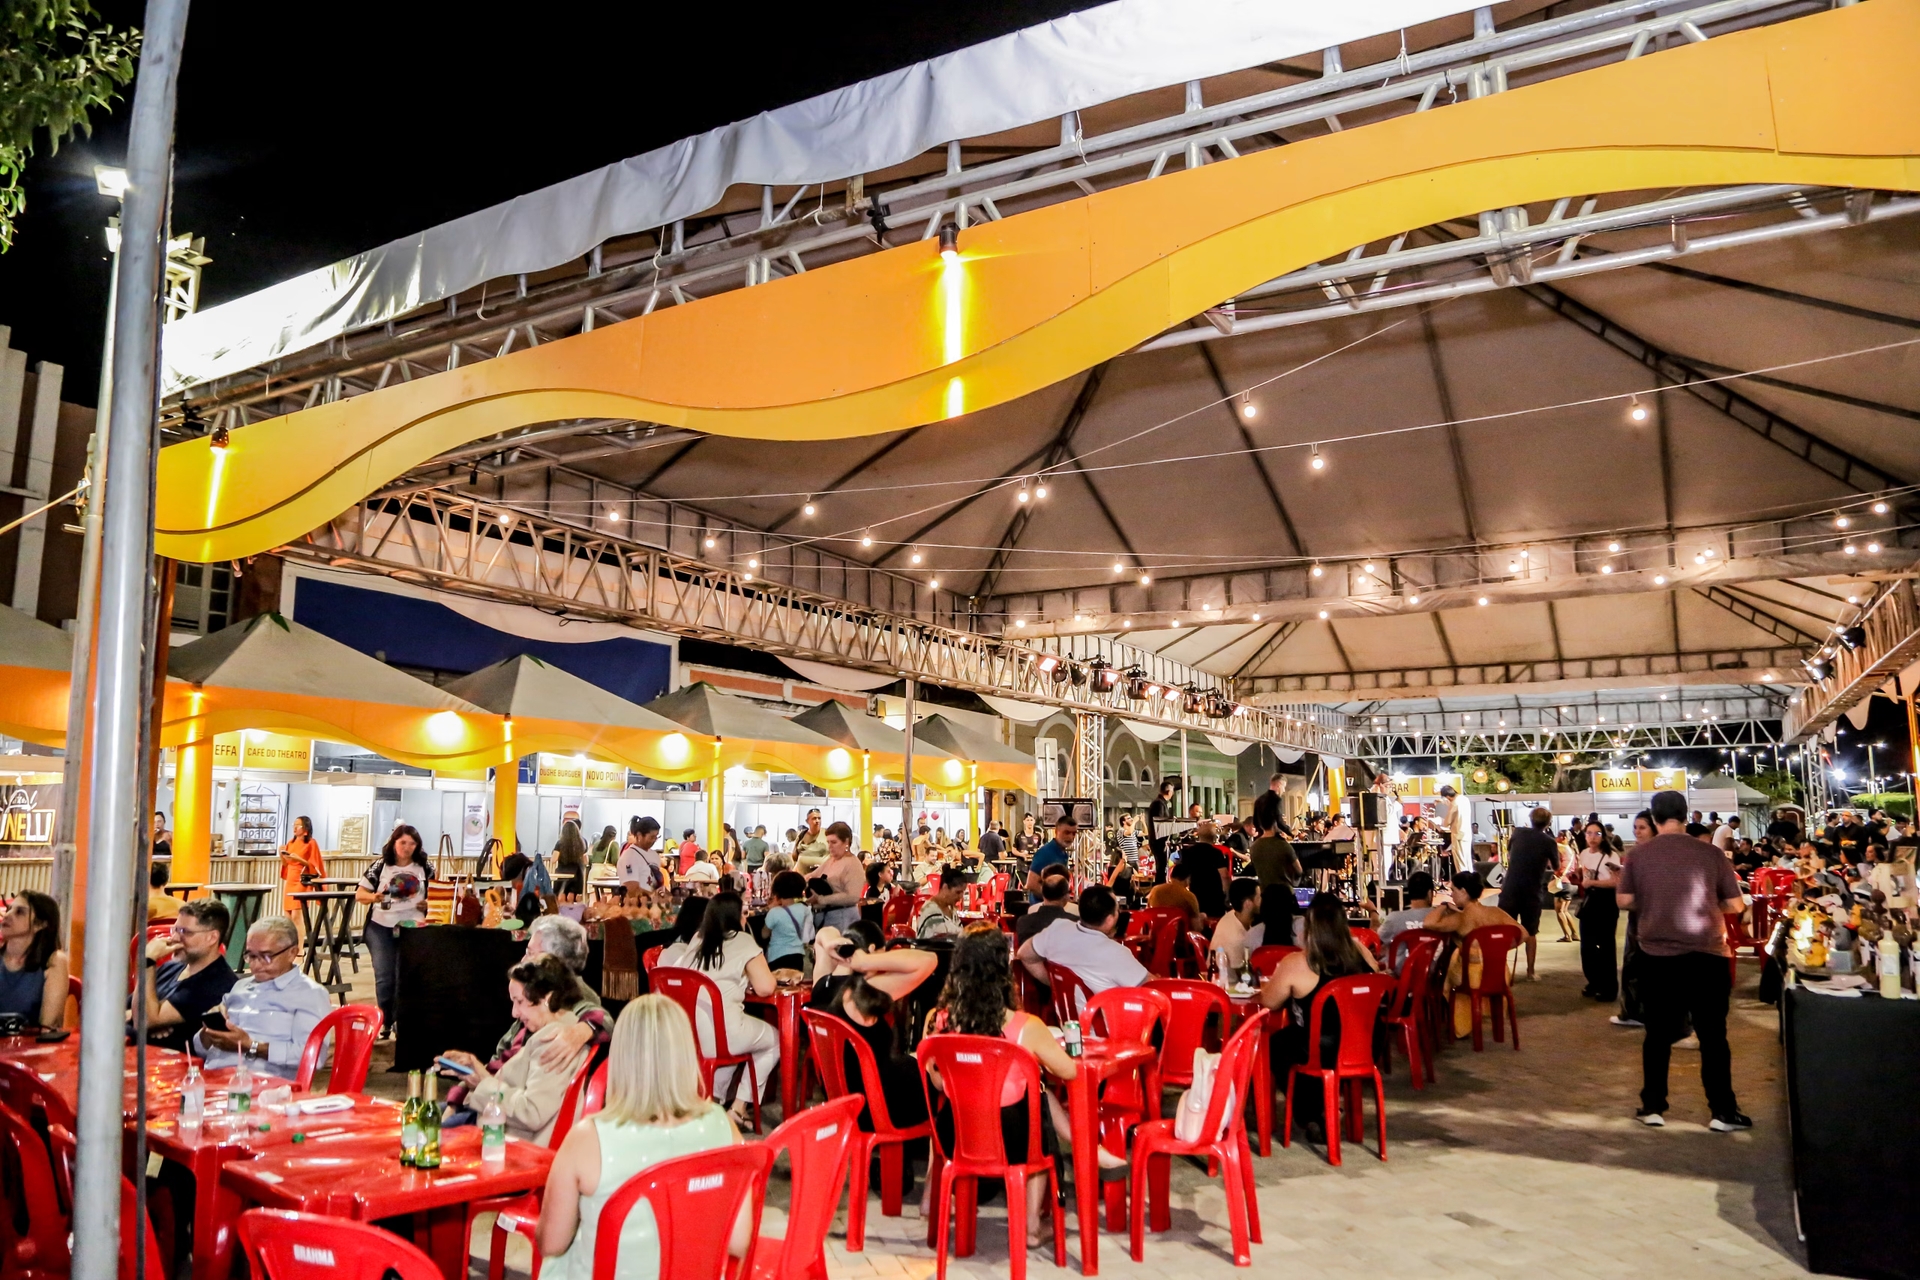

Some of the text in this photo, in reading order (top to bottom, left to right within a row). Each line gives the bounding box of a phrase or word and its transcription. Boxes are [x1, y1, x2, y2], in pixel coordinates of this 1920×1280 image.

[266, 749, 276, 758] DO
[277, 749, 307, 760] THEATRO
[586, 770, 625, 782] NOVO POINT
[1391, 782, 1409, 793] BAR
[1601, 778, 1631, 788] CAIXA
[688, 1173, 724, 1193] BRAHMA
[293, 1243, 335, 1267] BRAHMA
